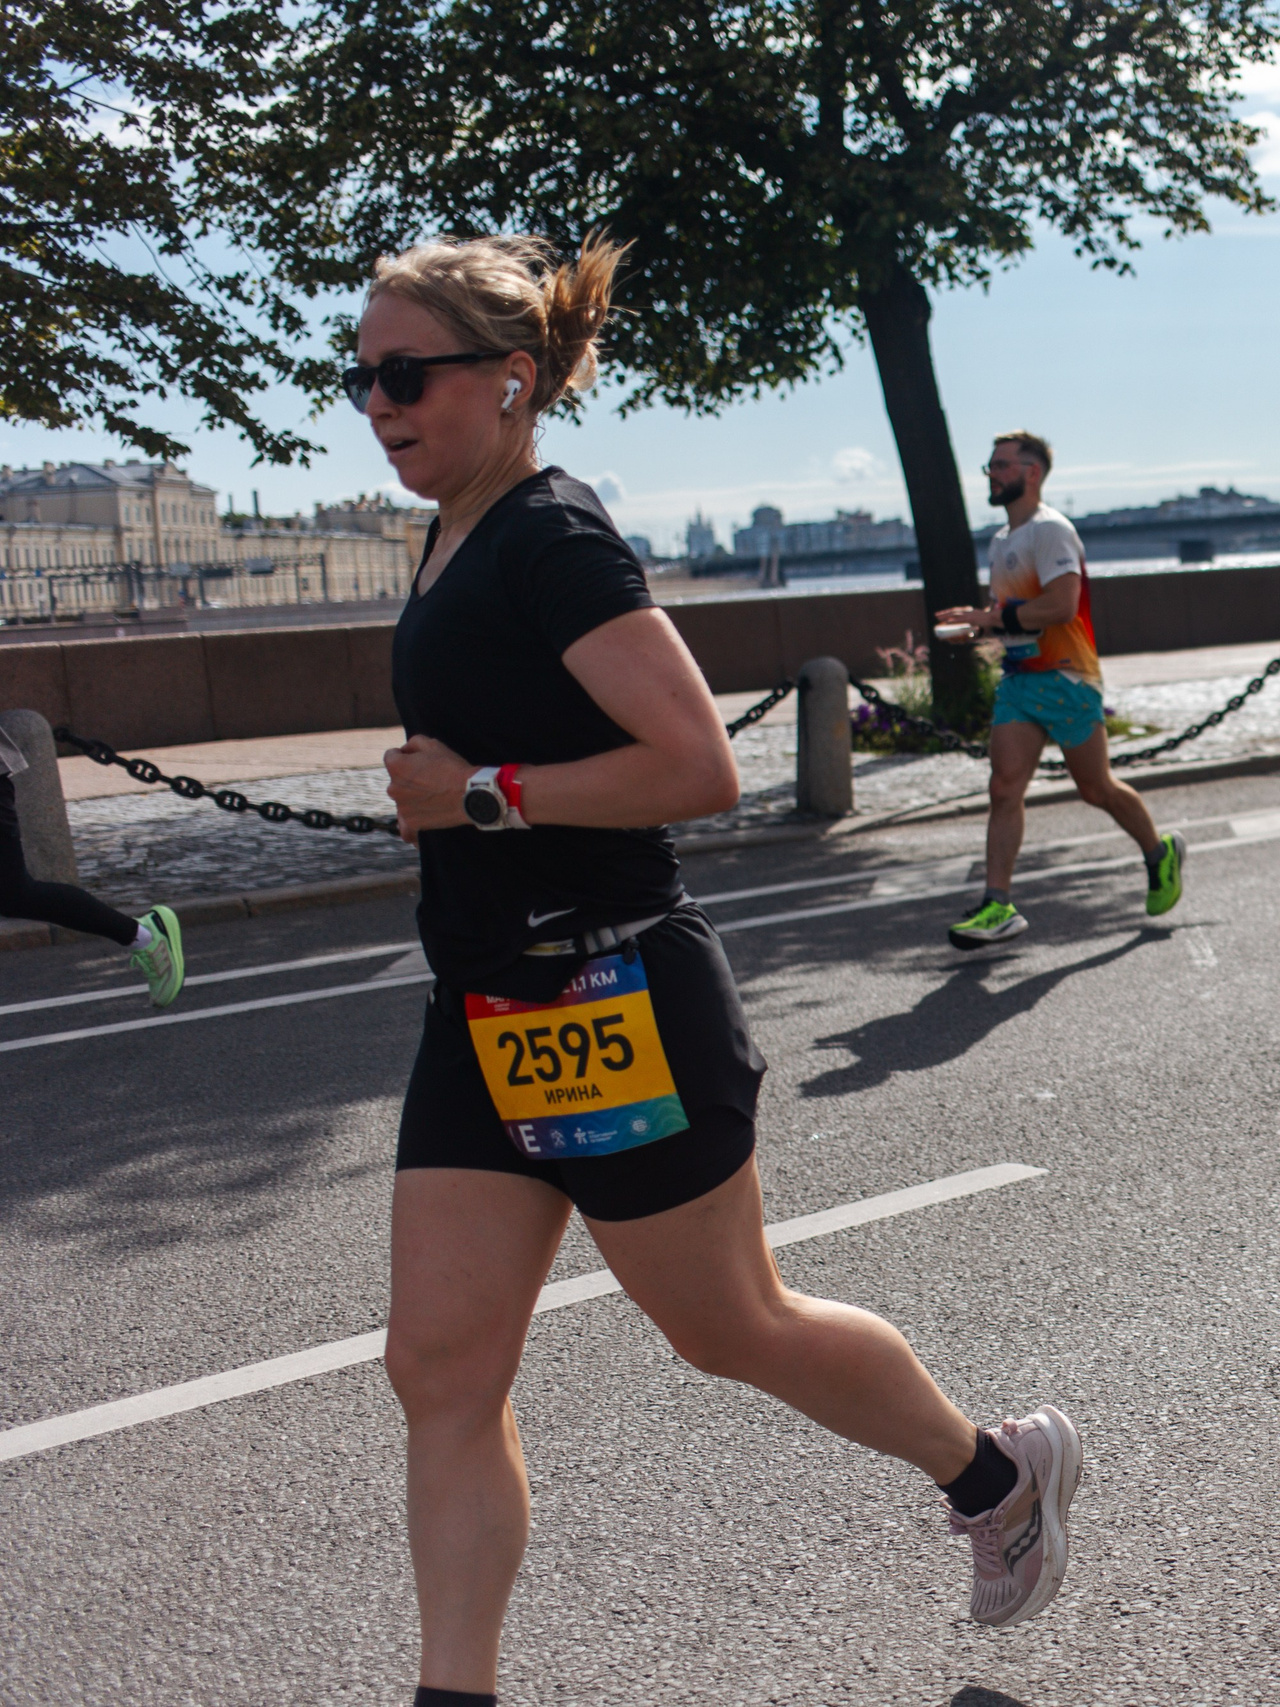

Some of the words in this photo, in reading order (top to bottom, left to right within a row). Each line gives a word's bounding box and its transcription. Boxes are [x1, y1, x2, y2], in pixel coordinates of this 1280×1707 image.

[590, 969, 618, 988] KM
[497, 1013, 635, 1087] 2595
[544, 1083, 604, 1105] ИРИНА
[518, 1124, 541, 1153] E
